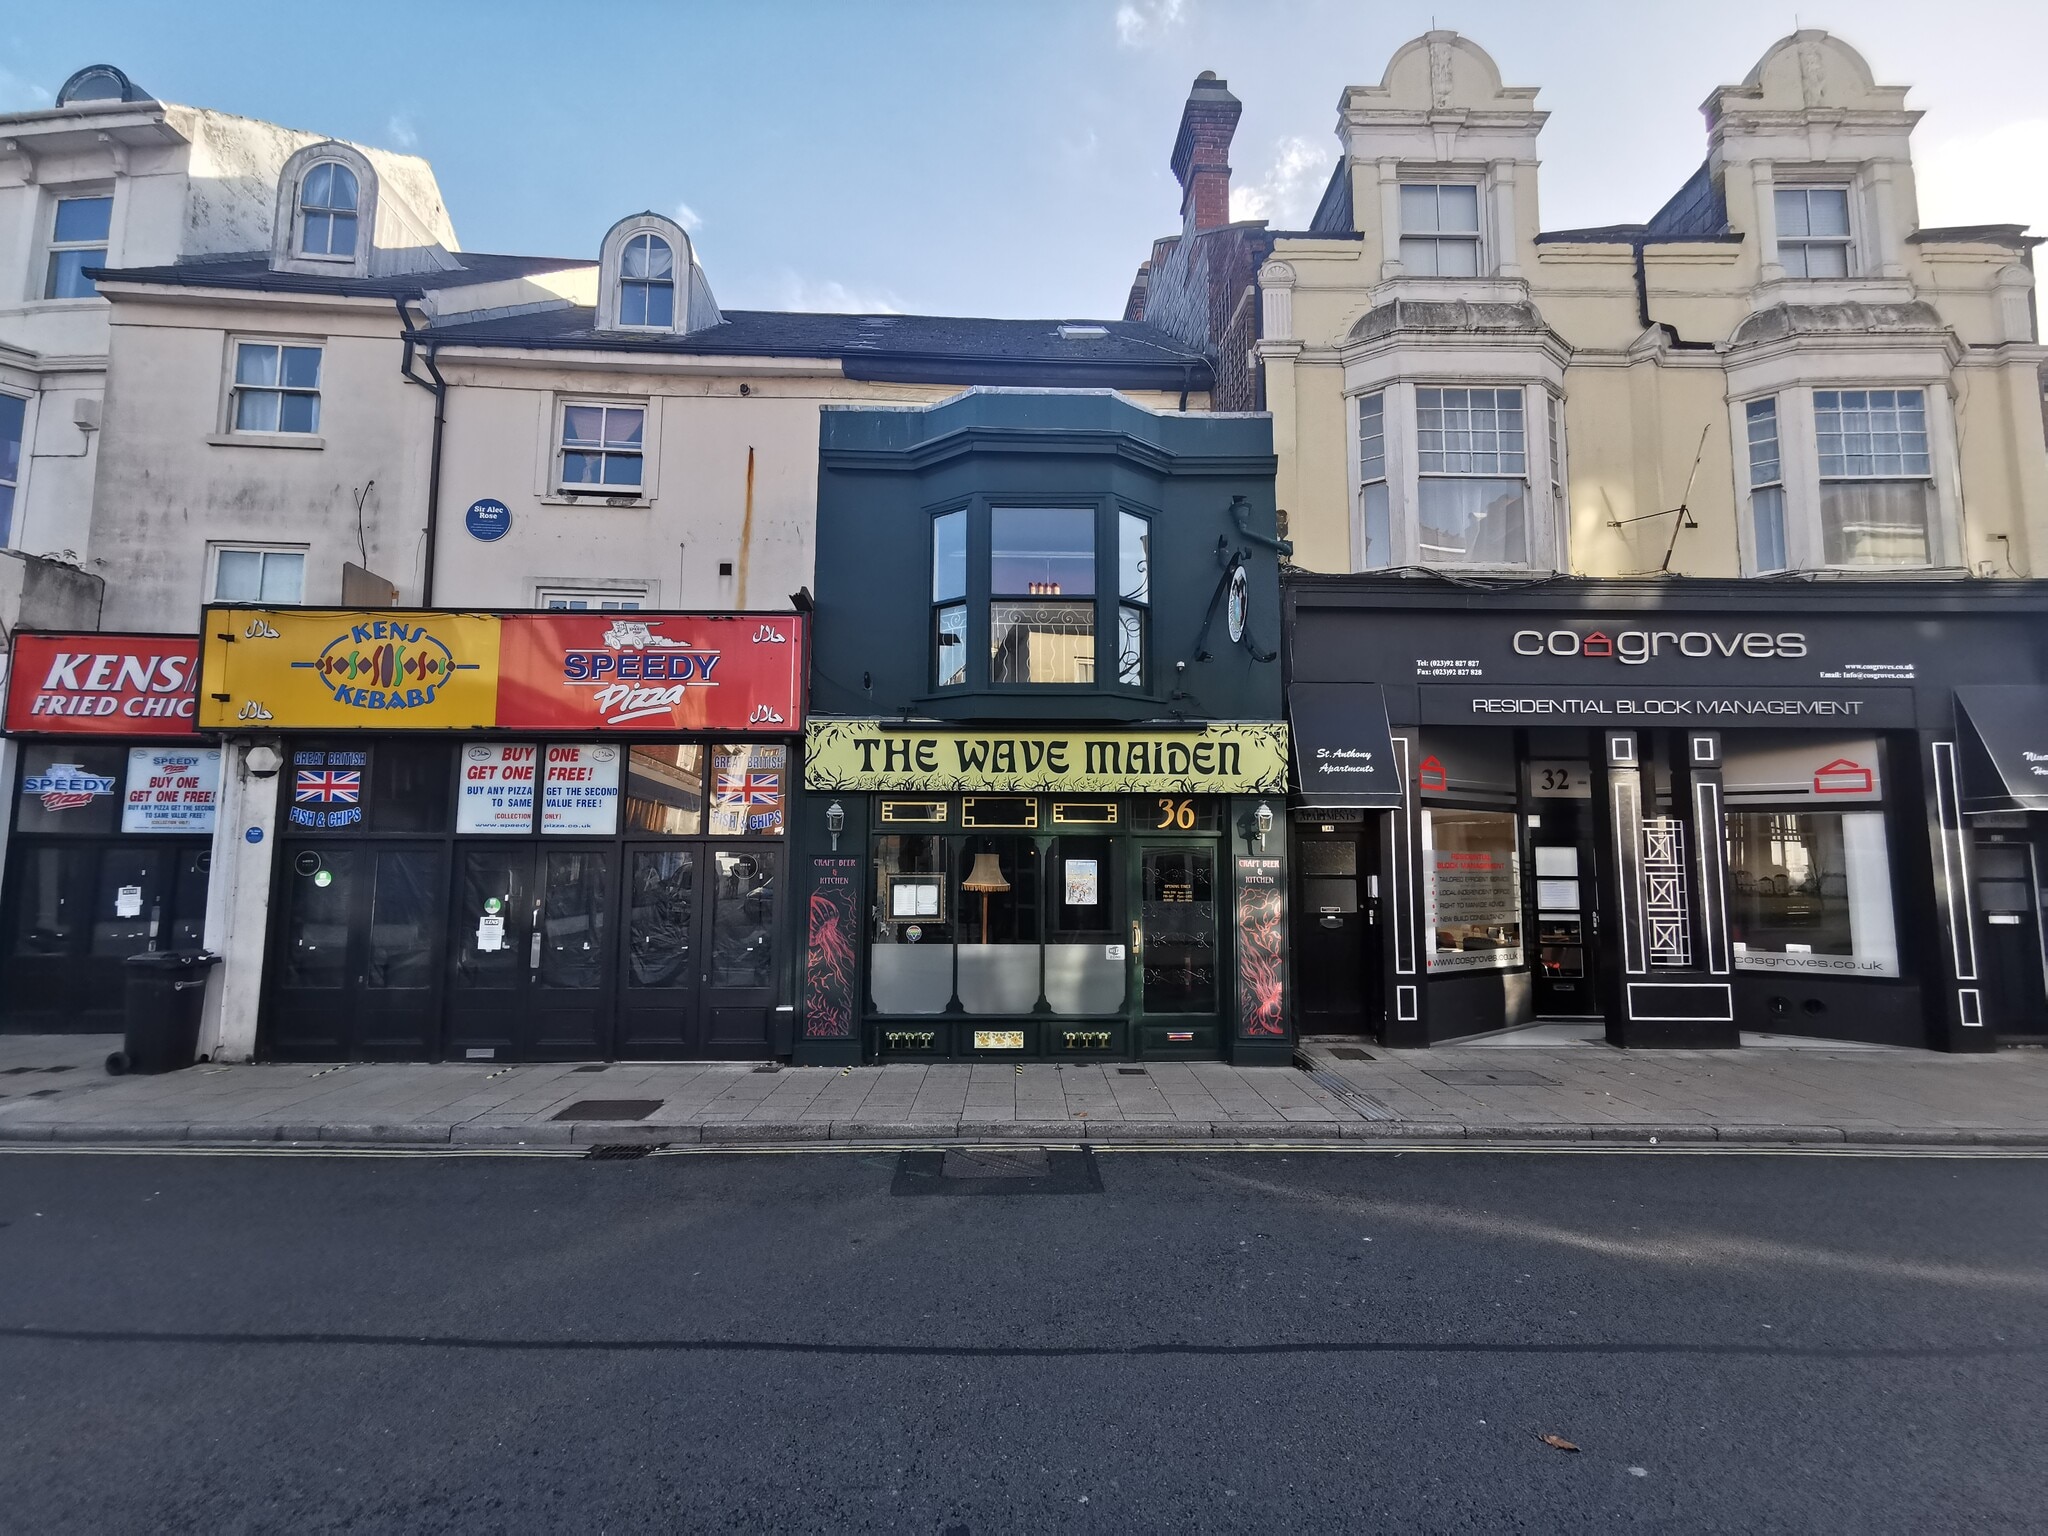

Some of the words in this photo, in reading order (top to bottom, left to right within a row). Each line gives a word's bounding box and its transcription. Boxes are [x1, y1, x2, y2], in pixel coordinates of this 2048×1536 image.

[351, 621, 427, 644] KENS
[42, 653, 187, 693] KENS
[563, 654, 721, 680] SPEEDY
[334, 684, 437, 711] KEBABS
[31, 696, 118, 716] FRIED
[1473, 700, 1613, 714] RESIDENTIAL
[1616, 700, 1691, 715] BLOCK
[1697, 700, 1864, 715] MANAGEMENT
[153, 757, 199, 765] SPEEDY
[294, 751, 325, 765] GREAT
[328, 752, 366, 765] BRITISH
[501, 747, 534, 762] BUY
[548, 748, 580, 762] ONE
[854, 738, 939, 773] THE
[955, 740, 1070, 774] WAVE
[747, 756, 784, 769] BRITISH
[1319, 763, 1375, 774] Apartments
[467, 766, 498, 780] GET
[501, 766, 534, 781] ONE
[547, 768, 593, 781] FREE!
[1541, 769, 1570, 790] 32
[24, 778, 112, 791] SPEEDY
[149, 777, 173, 788] BUY
[176, 777, 200, 788] ONE
[129, 791, 152, 802] GET
[156, 791, 179, 802] ONE
[183, 792, 216, 803] FREE!
[467, 786, 484, 795] BUY
[487, 786, 505, 795] ANY
[508, 787, 532, 795] PIZZA
[546, 787, 562, 796] GET
[566, 788, 582, 796] THE
[584, 788, 618, 796] SECOND
[492, 799, 503, 807] TO
[508, 799, 532, 807] SAME
[546, 799, 572, 808] VALUE
[576, 799, 602, 808] FREE!
[289, 806, 316, 827] FISH
[316, 812, 326, 827] &
[328, 807, 362, 827] CHIPS
[749, 810, 782, 830] CHIPS
[1157, 798, 1195, 829] 36
[1263, 860, 1280, 868] BEER
